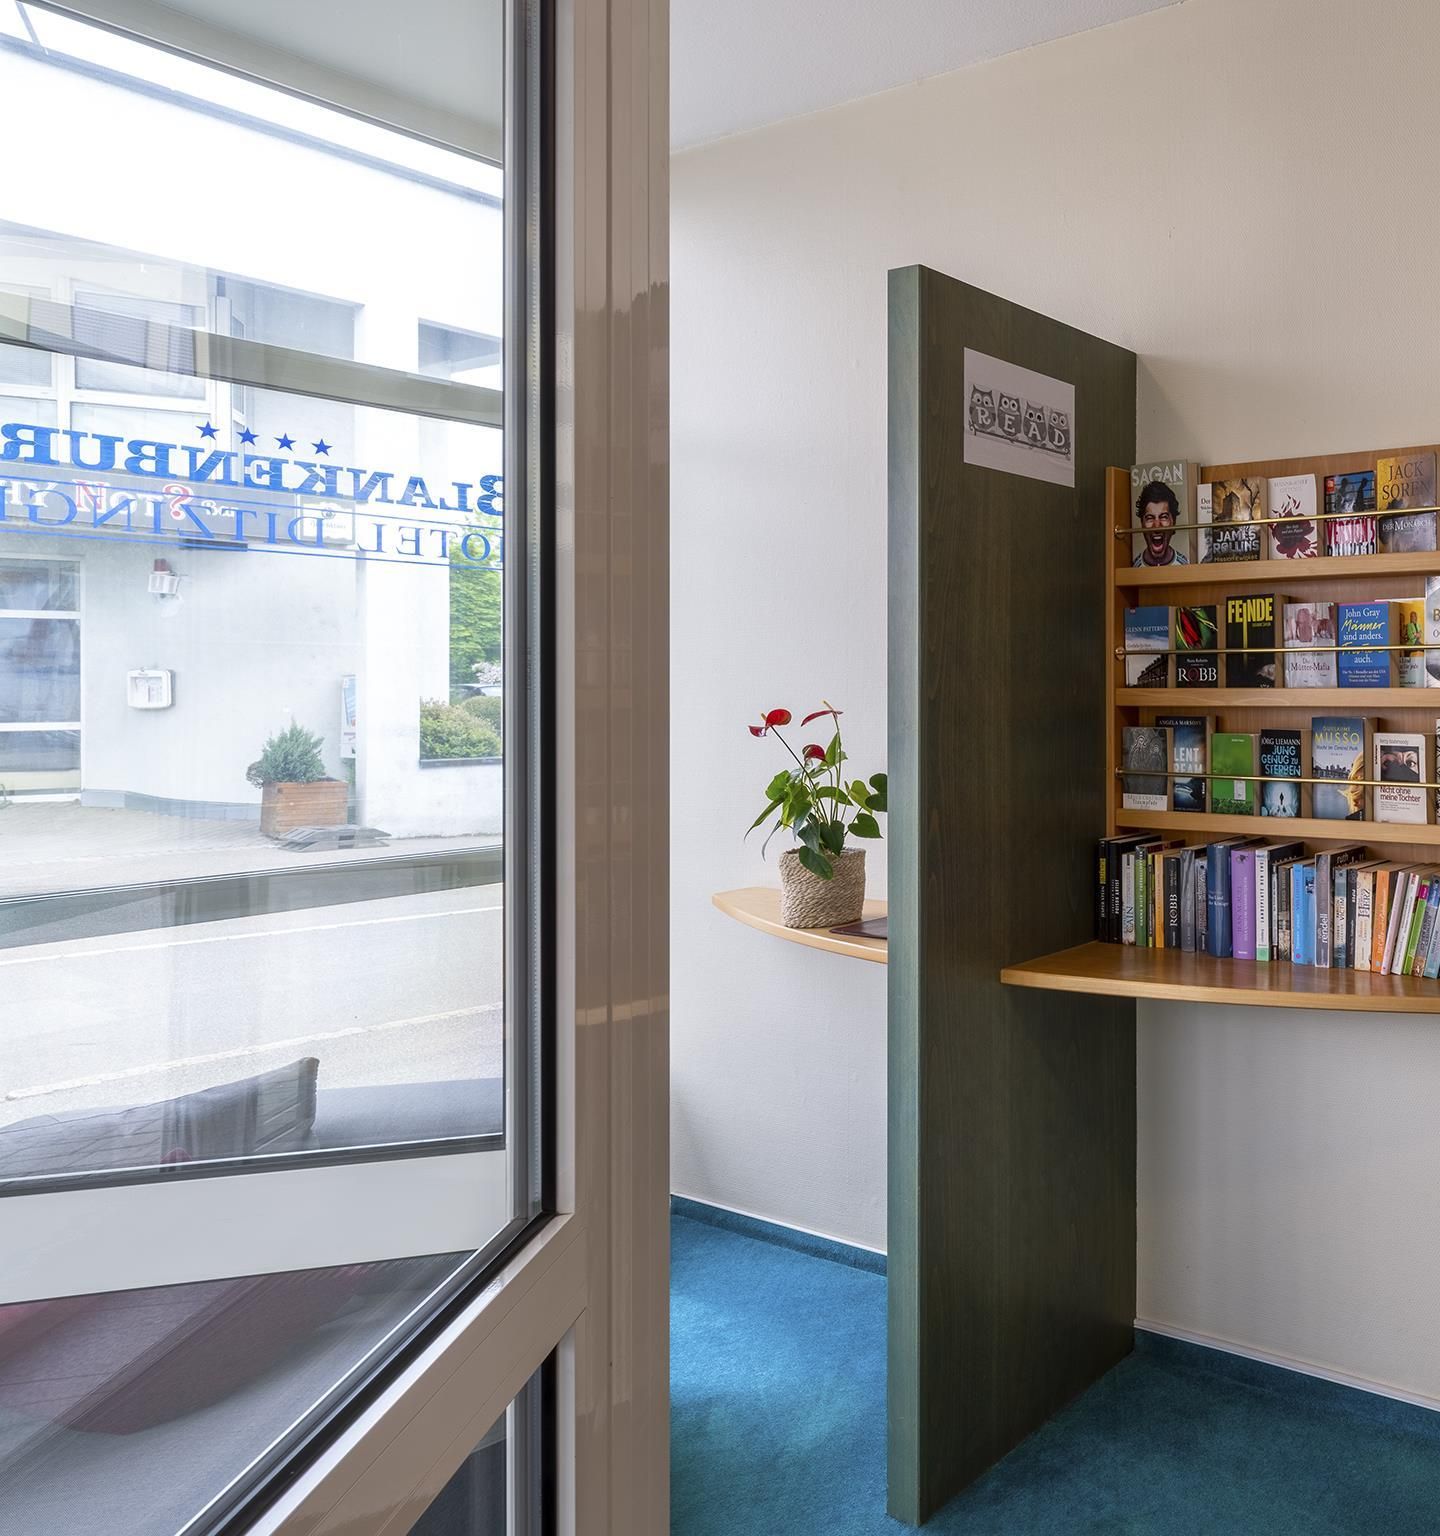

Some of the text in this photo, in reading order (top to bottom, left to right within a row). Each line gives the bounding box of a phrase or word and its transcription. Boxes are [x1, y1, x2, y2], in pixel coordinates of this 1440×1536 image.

[976, 407, 1066, 447] READ
[1131, 464, 1183, 487] SAGAN
[1389, 461, 1424, 482] JACK
[1382, 480, 1431, 500] SOREN
[1216, 530, 1257, 543] JAMES
[1213, 540, 1260, 554] ROLLINS
[1228, 598, 1273, 624] FEINDE
[1345, 608, 1380, 620] John Gray
[1125, 624, 1169, 633] GLENN PATTERSON
[1341, 619, 1385, 632] Männer
[1343, 631, 1383, 641] sind anders.
[1354, 655, 1373, 664] auch.
[1178, 667, 1217, 682] ROBB
[1314, 731, 1360, 745] MUSSO
[1272, 746, 1296, 756] JUNG
[1261, 754, 1289, 765] GENUG
[1264, 764, 1301, 776] STERBEN
[1379, 785, 1411, 795] Nicht ohne
[1380, 793, 1421, 803] meine Tochter
[1169, 894, 1178, 927] ROBB
[1126, 906, 1134, 933] CAIN
[1320, 913, 1328, 943] rendell
